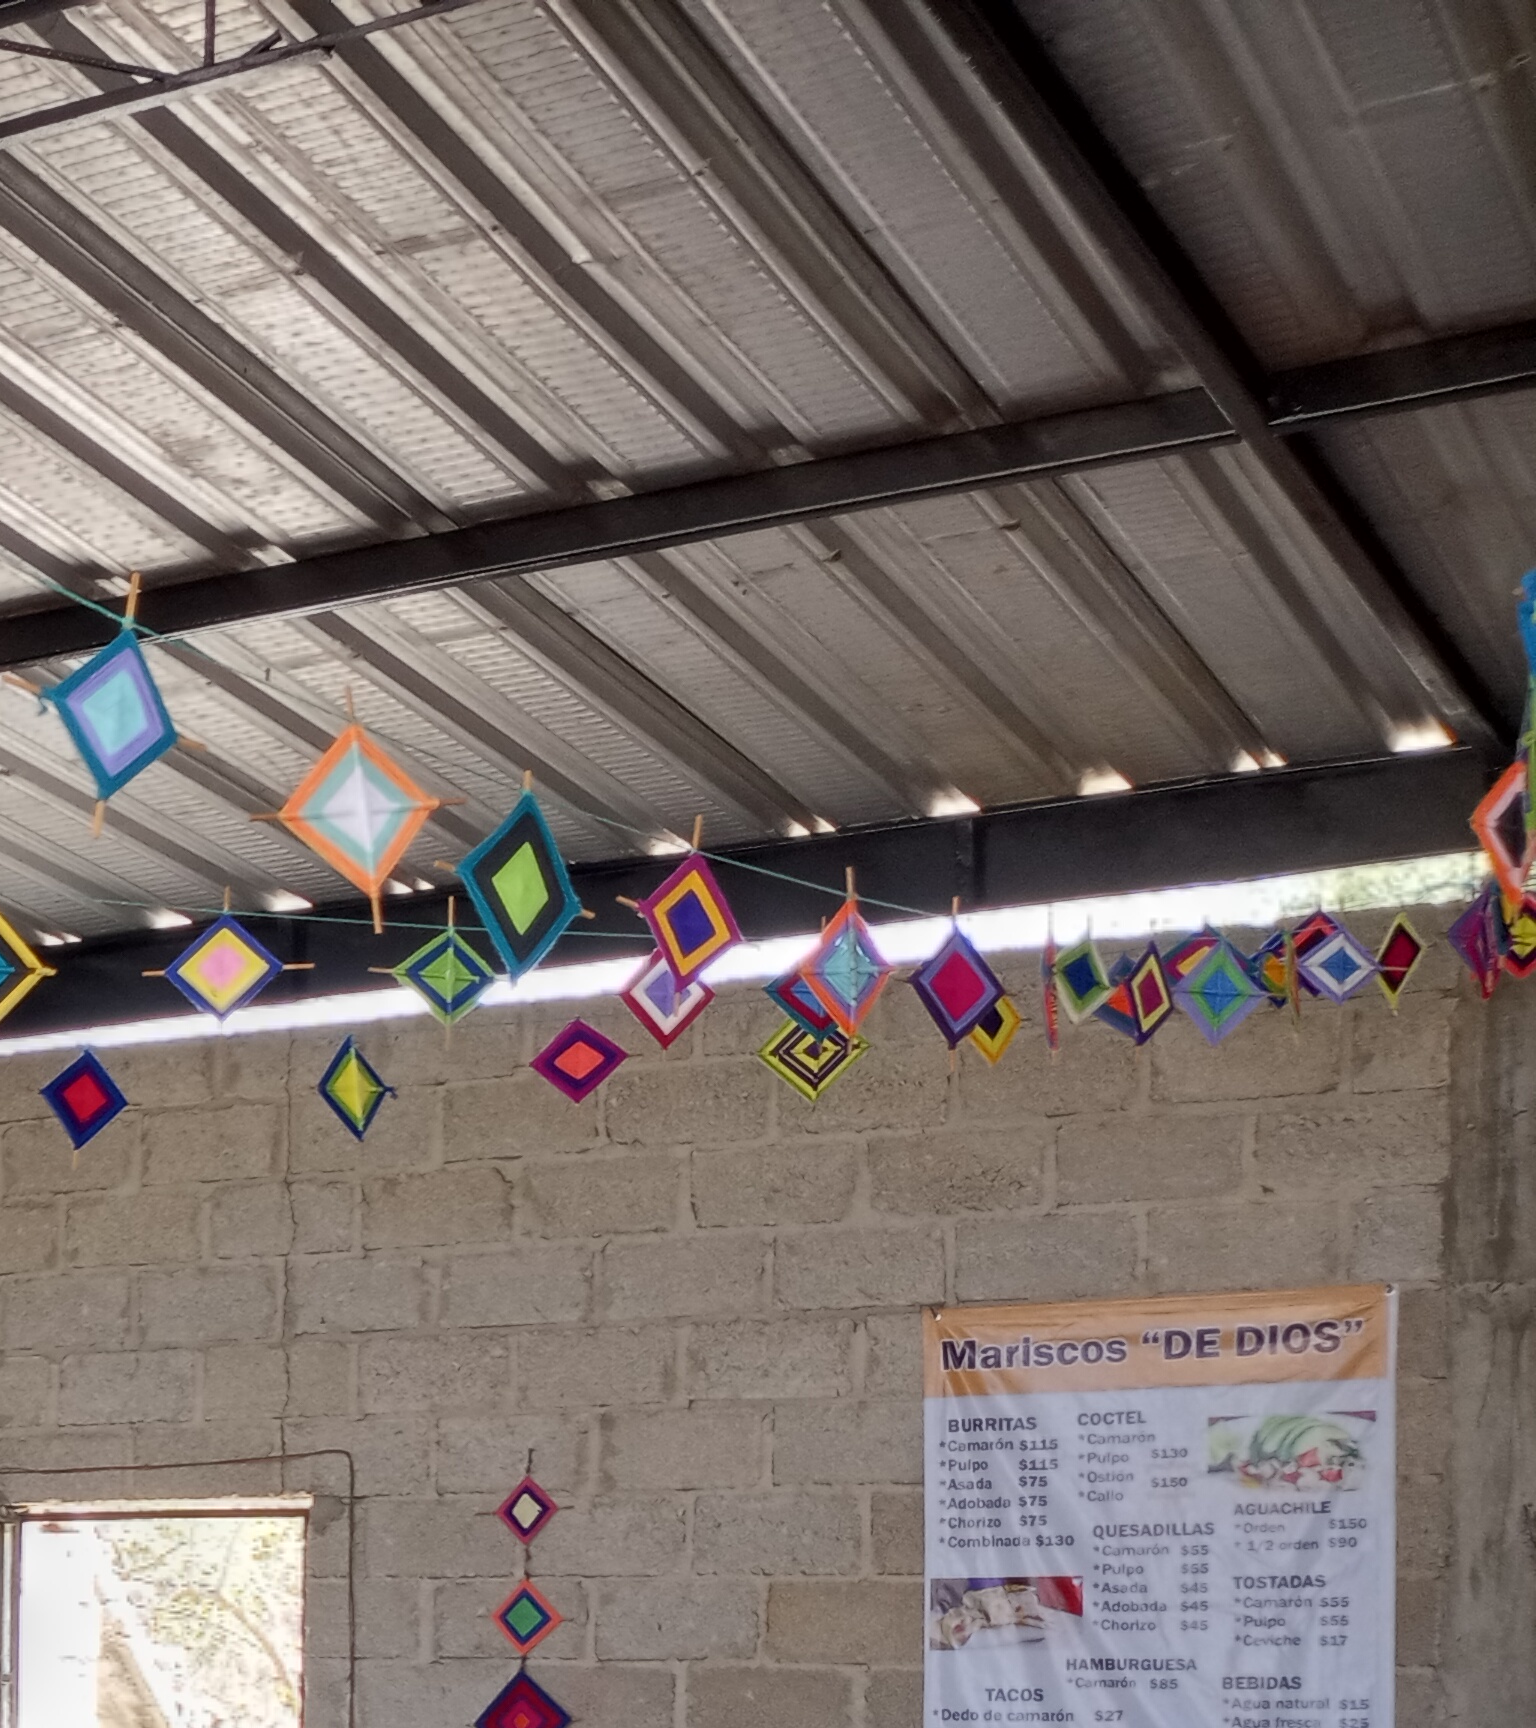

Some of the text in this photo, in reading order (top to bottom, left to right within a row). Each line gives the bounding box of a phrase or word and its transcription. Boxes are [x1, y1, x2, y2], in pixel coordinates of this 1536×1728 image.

[940, 1336, 1129, 1371] Mariscos
[1077, 1410, 1147, 1425] COCTEL
[948, 1416, 1038, 1433] BURRITAS
[1019, 1438, 1058, 1451] $115
[1018, 1458, 1058, 1471] $115
[1018, 1476, 1048, 1488] $75
[1018, 1496, 1048, 1508] $75
[1234, 1501, 1332, 1516] AGUACHILE
[1018, 1515, 1048, 1527] $75
[1092, 1522, 1215, 1539] QUESADILLAS
[1035, 1534, 1075, 1547] $130
[1180, 1545, 1209, 1556] $55
[1180, 1563, 1209, 1574] $55
[1180, 1582, 1208, 1594] $45
[1233, 1575, 1327, 1589] TOSTADAS
[1180, 1601, 1209, 1612] $45
[1180, 1620, 1208, 1631] $45
[1066, 1658, 1197, 1671] HAMBURGUESA
[1149, 1678, 1178, 1689] $85
[1222, 1676, 1302, 1690] BEBIDAS
[985, 1688, 1044, 1702] TACOS
[984, 1710, 1002, 1721] de
[1007, 1708, 1074, 1722] camarón
[1094, 1710, 1123, 1722] $27
